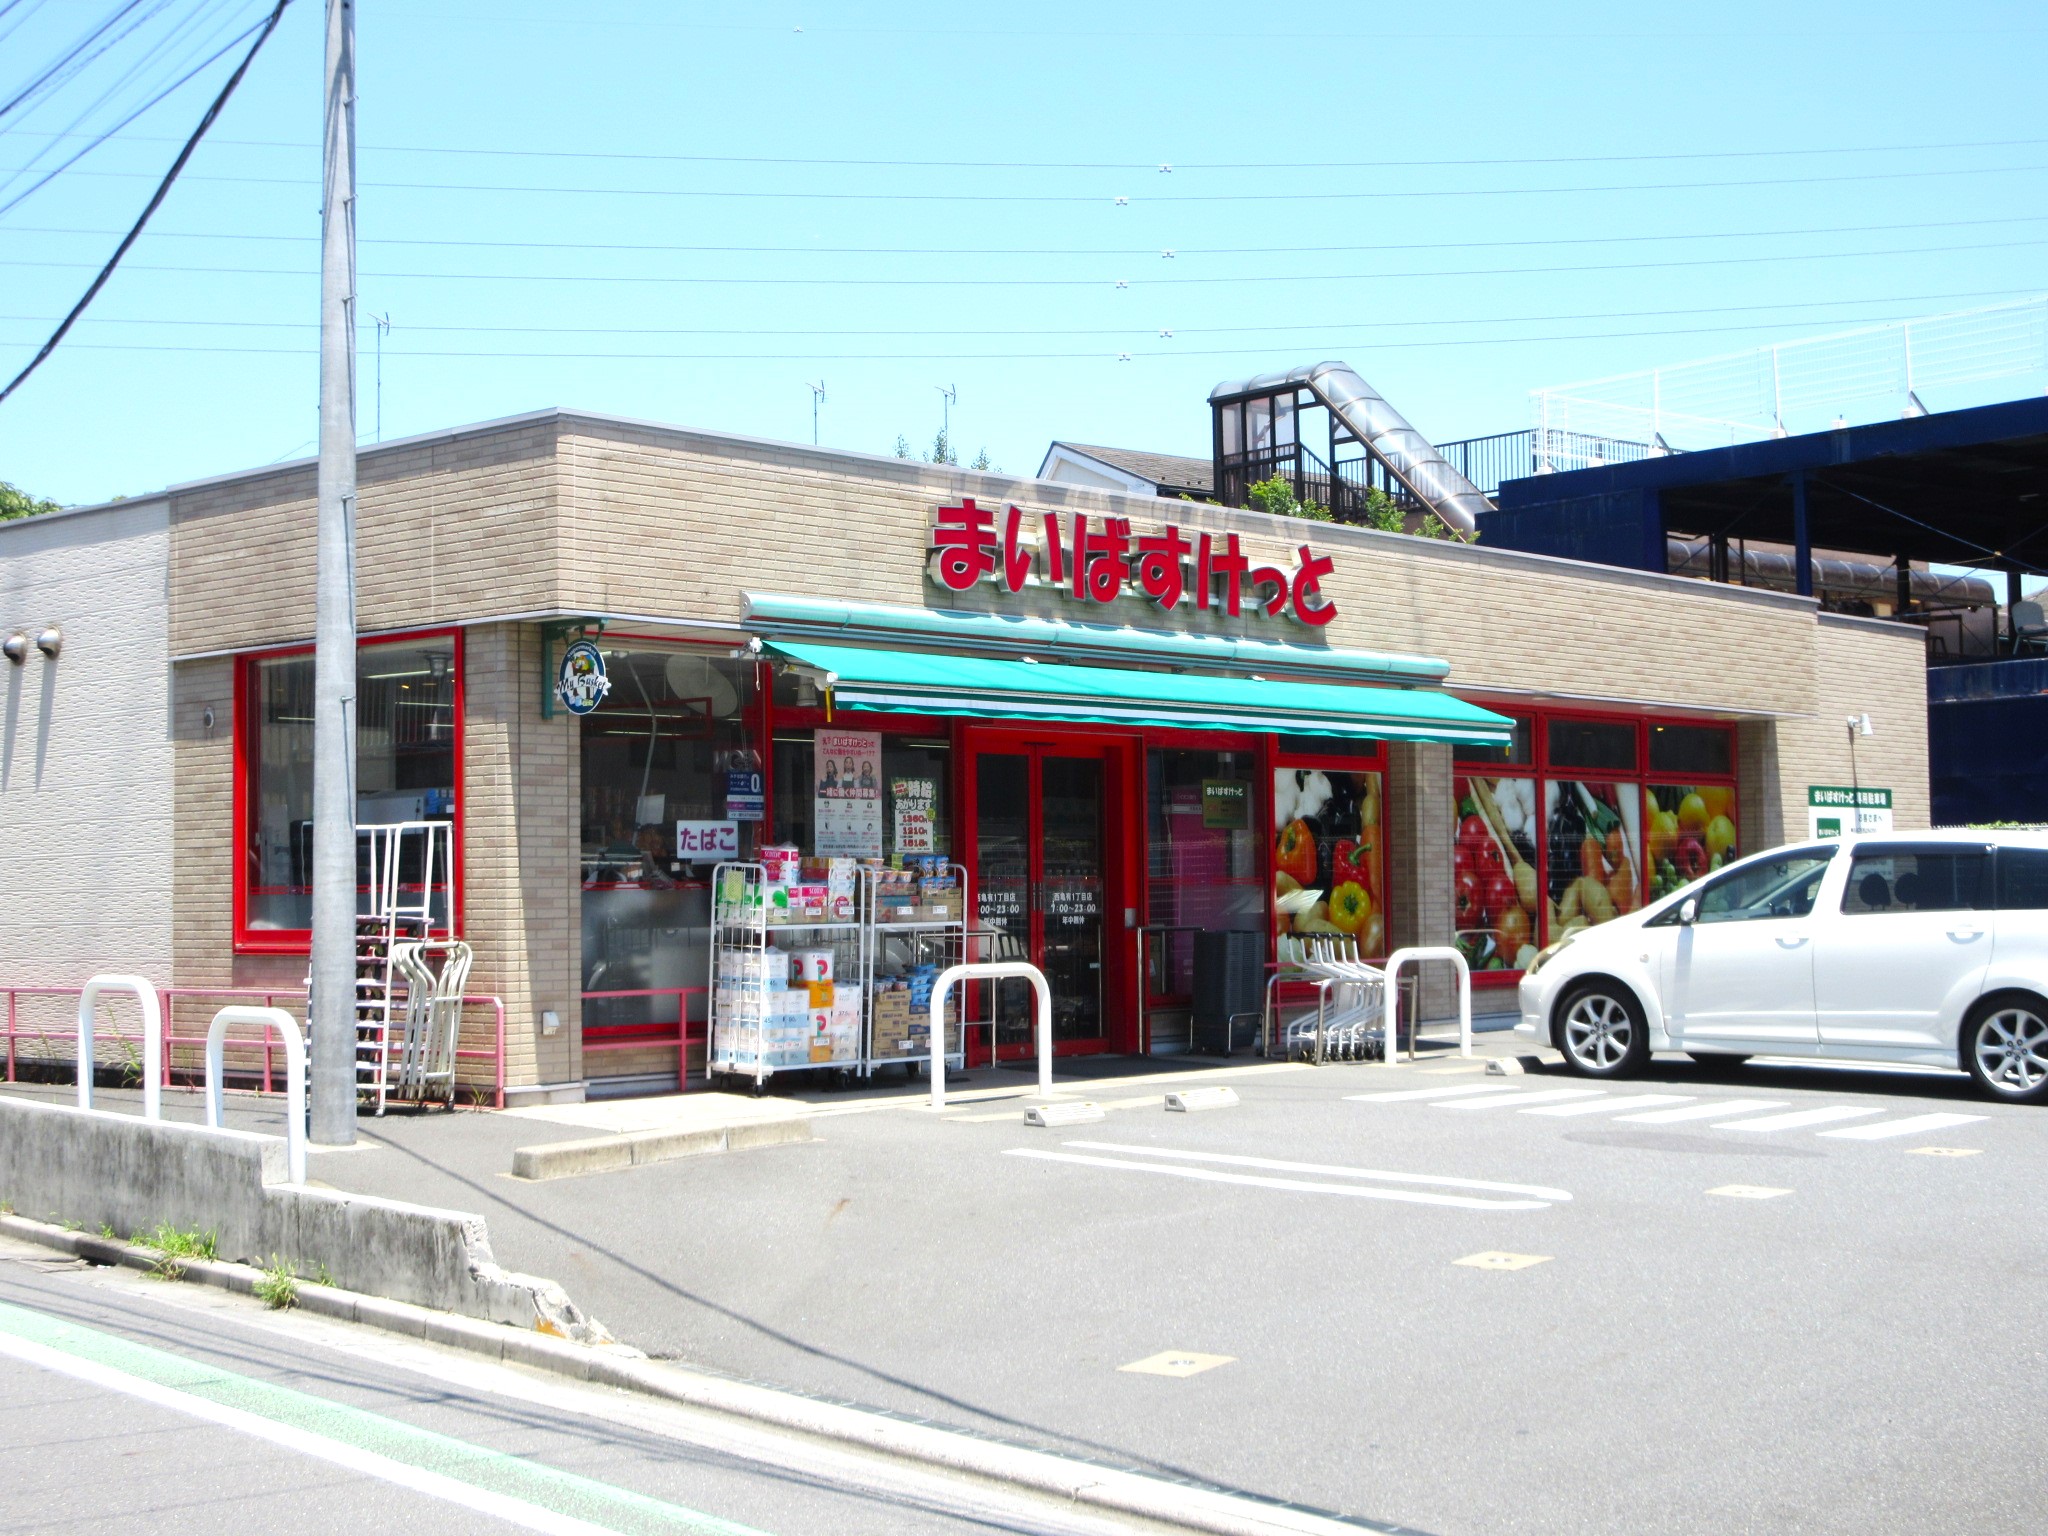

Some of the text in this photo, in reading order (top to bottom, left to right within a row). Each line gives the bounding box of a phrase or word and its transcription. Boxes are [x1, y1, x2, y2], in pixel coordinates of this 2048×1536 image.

[930, 498, 1338, 627] まいばすけっと
[556, 674, 606, 693] My Basket
[907, 780, 932, 798] 時給
[1206, 786, 1243, 796] まいばすけっと
[1814, 790, 1855, 804] まいばすけっと
[895, 799, 931, 811] あがります
[680, 827, 736, 851] たばこ
[1053, 892, 1093, 901] 西亀有1丁目店
